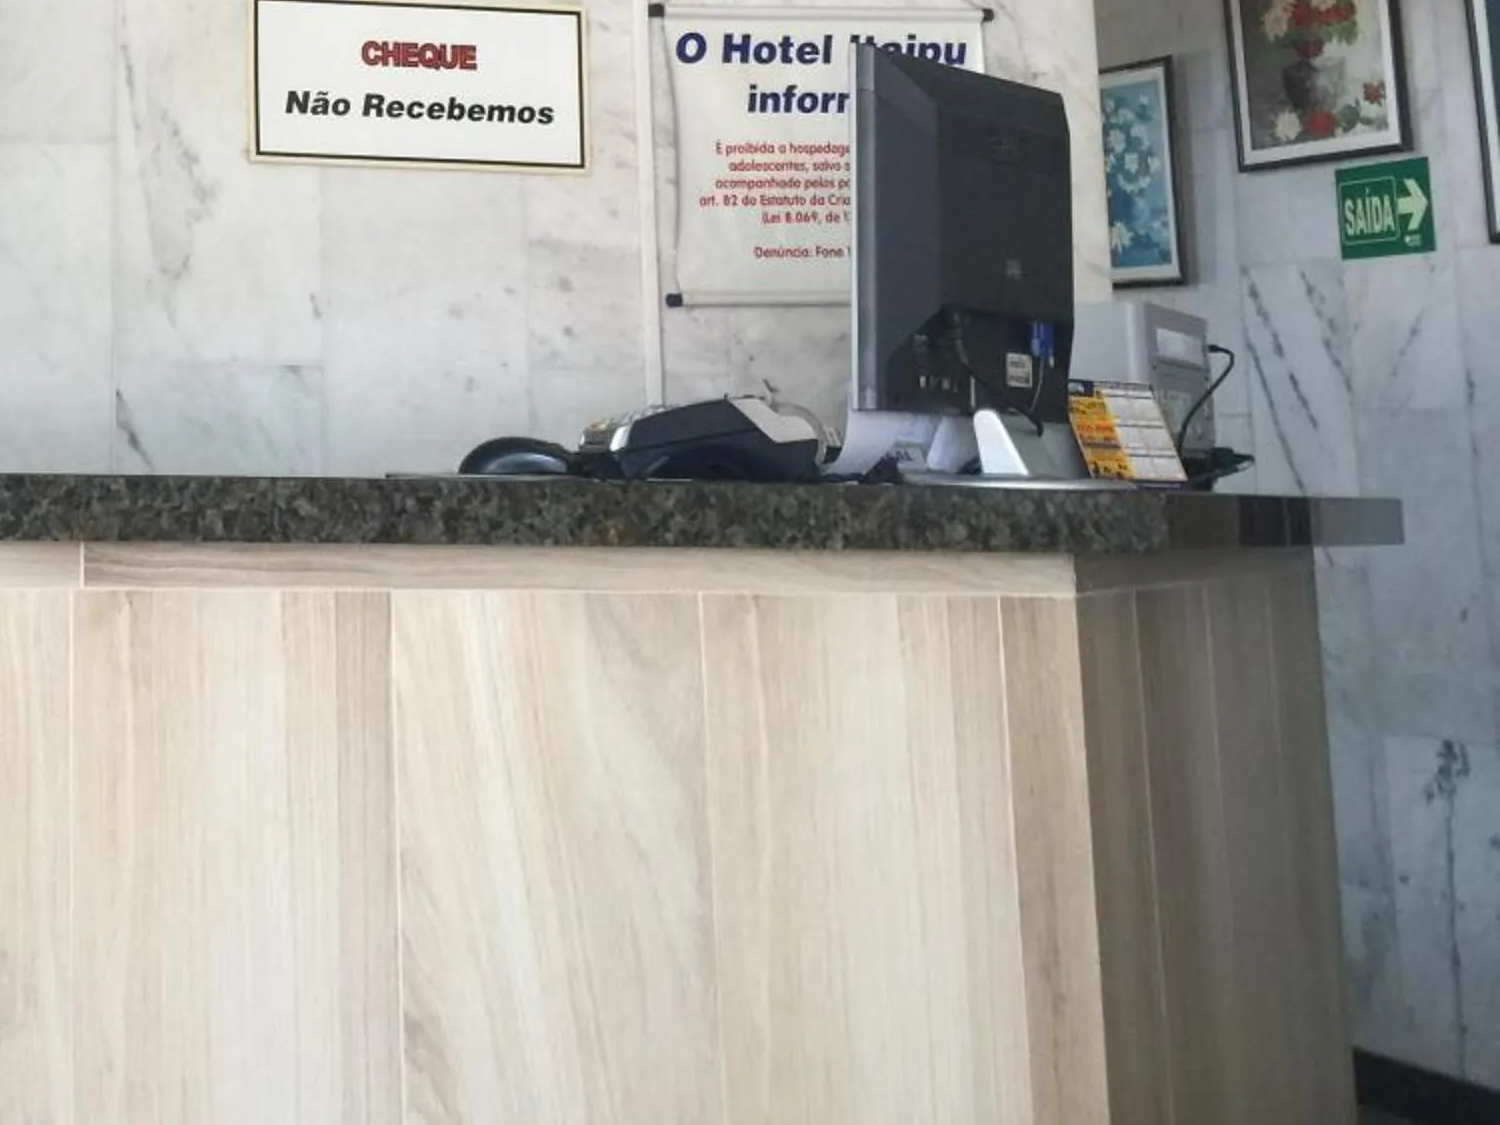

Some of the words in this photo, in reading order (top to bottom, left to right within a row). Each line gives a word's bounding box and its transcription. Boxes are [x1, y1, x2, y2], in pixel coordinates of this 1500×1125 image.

[361, 40, 478, 71] CHEQUE
[675, 31, 707, 65] O
[721, 33, 833, 65] Hotel
[285, 90, 351, 117] Não
[362, 92, 555, 125] Recebemos
[725, 142, 775, 156] proibida
[759, 194, 806, 207] Estatuto
[1344, 186, 1395, 236] SAÍDA
